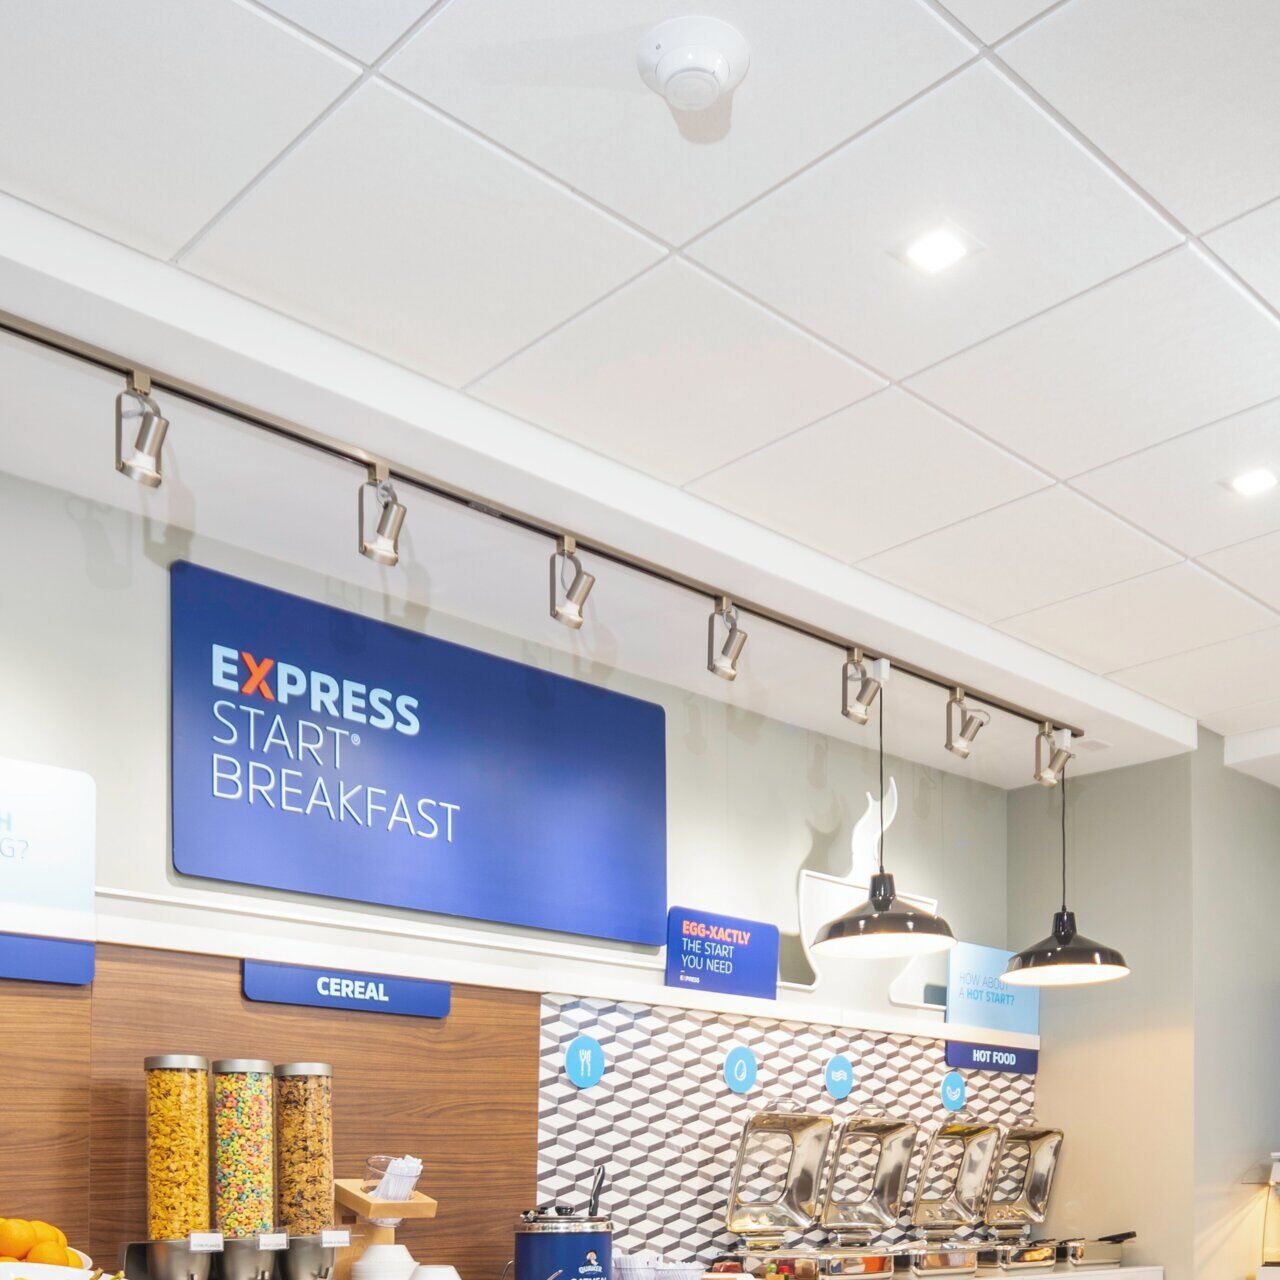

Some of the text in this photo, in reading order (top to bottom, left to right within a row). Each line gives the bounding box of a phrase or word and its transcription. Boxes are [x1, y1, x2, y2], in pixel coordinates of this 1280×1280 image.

[211, 642, 420, 737] EXPRESS
[212, 752, 461, 843] BREAKFAST
[682, 920, 751, 945] EGG-XACTLY
[682, 937, 735, 958] THE START
[681, 954, 733, 974] YOU NEED
[316, 976, 389, 1001] CEREAL
[967, 989, 984, 1000] HOT
[986, 991, 1015, 1006] START?
[972, 1049, 1017, 1065] HOT FOOD
